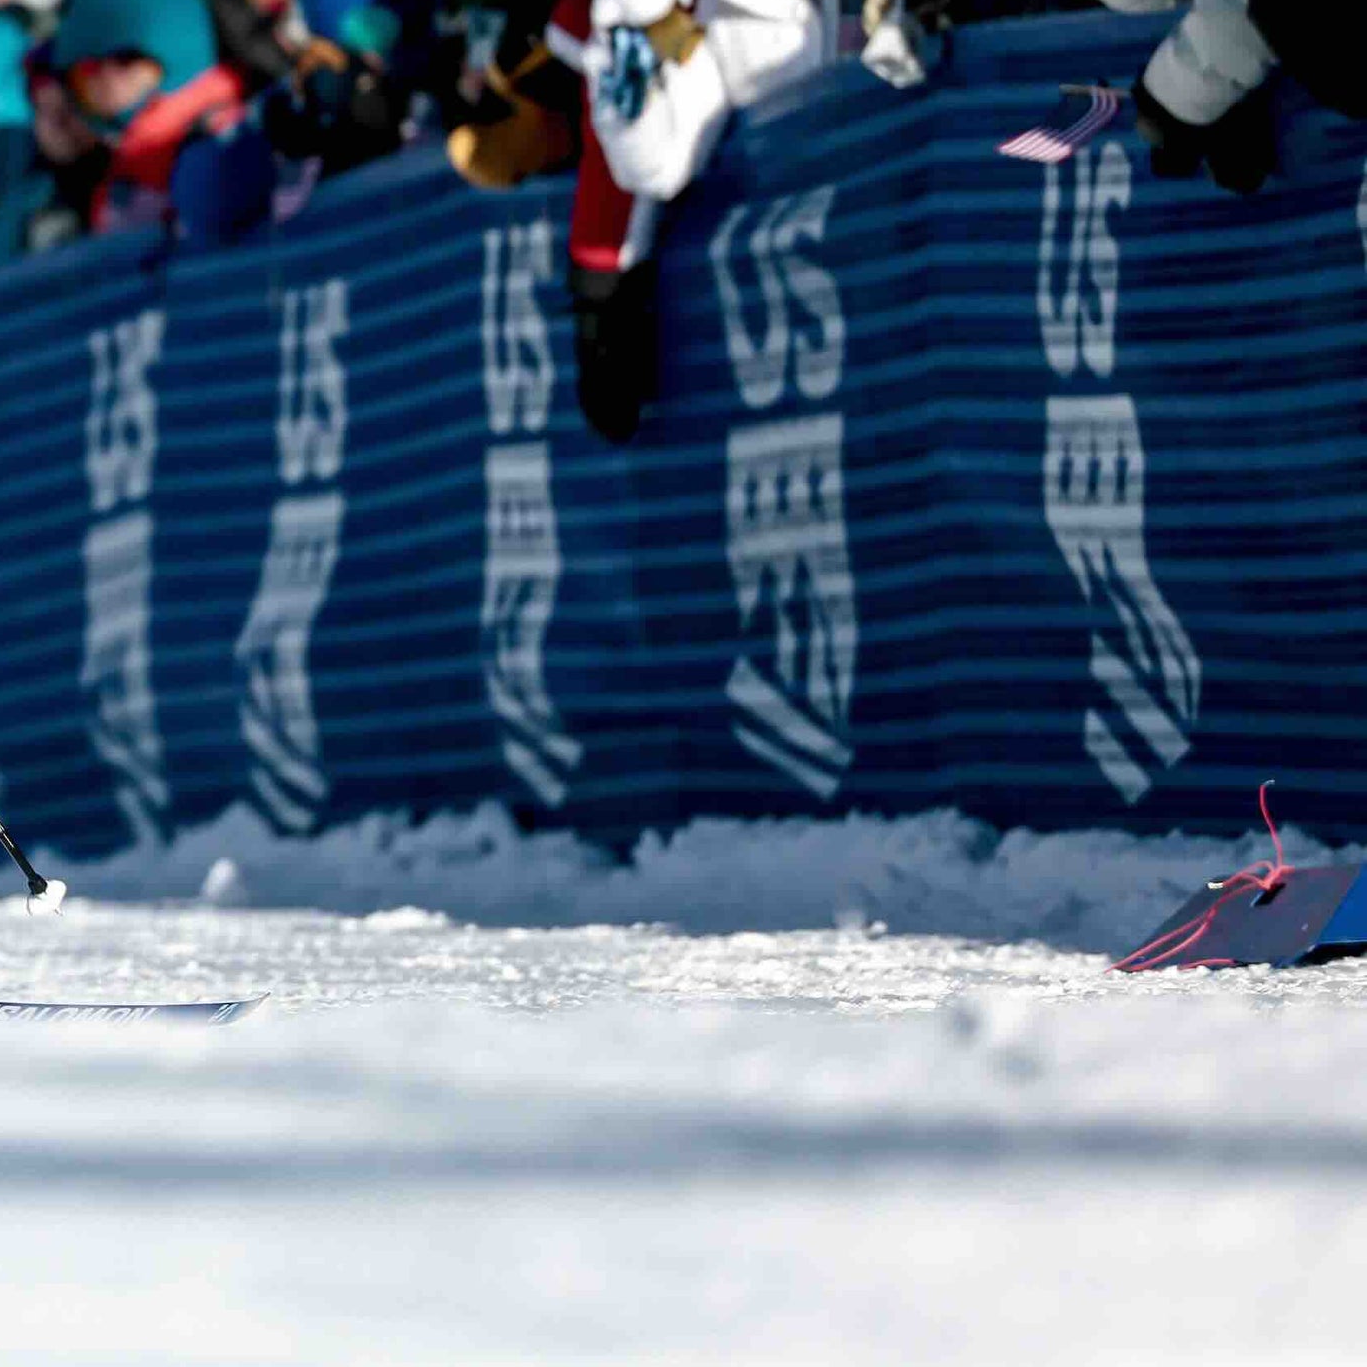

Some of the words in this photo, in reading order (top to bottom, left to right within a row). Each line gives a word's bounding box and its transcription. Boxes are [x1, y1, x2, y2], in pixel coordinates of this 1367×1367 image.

[277, 279, 350, 485] US
[483, 220, 556, 434] US
[710, 187, 846, 408] US
